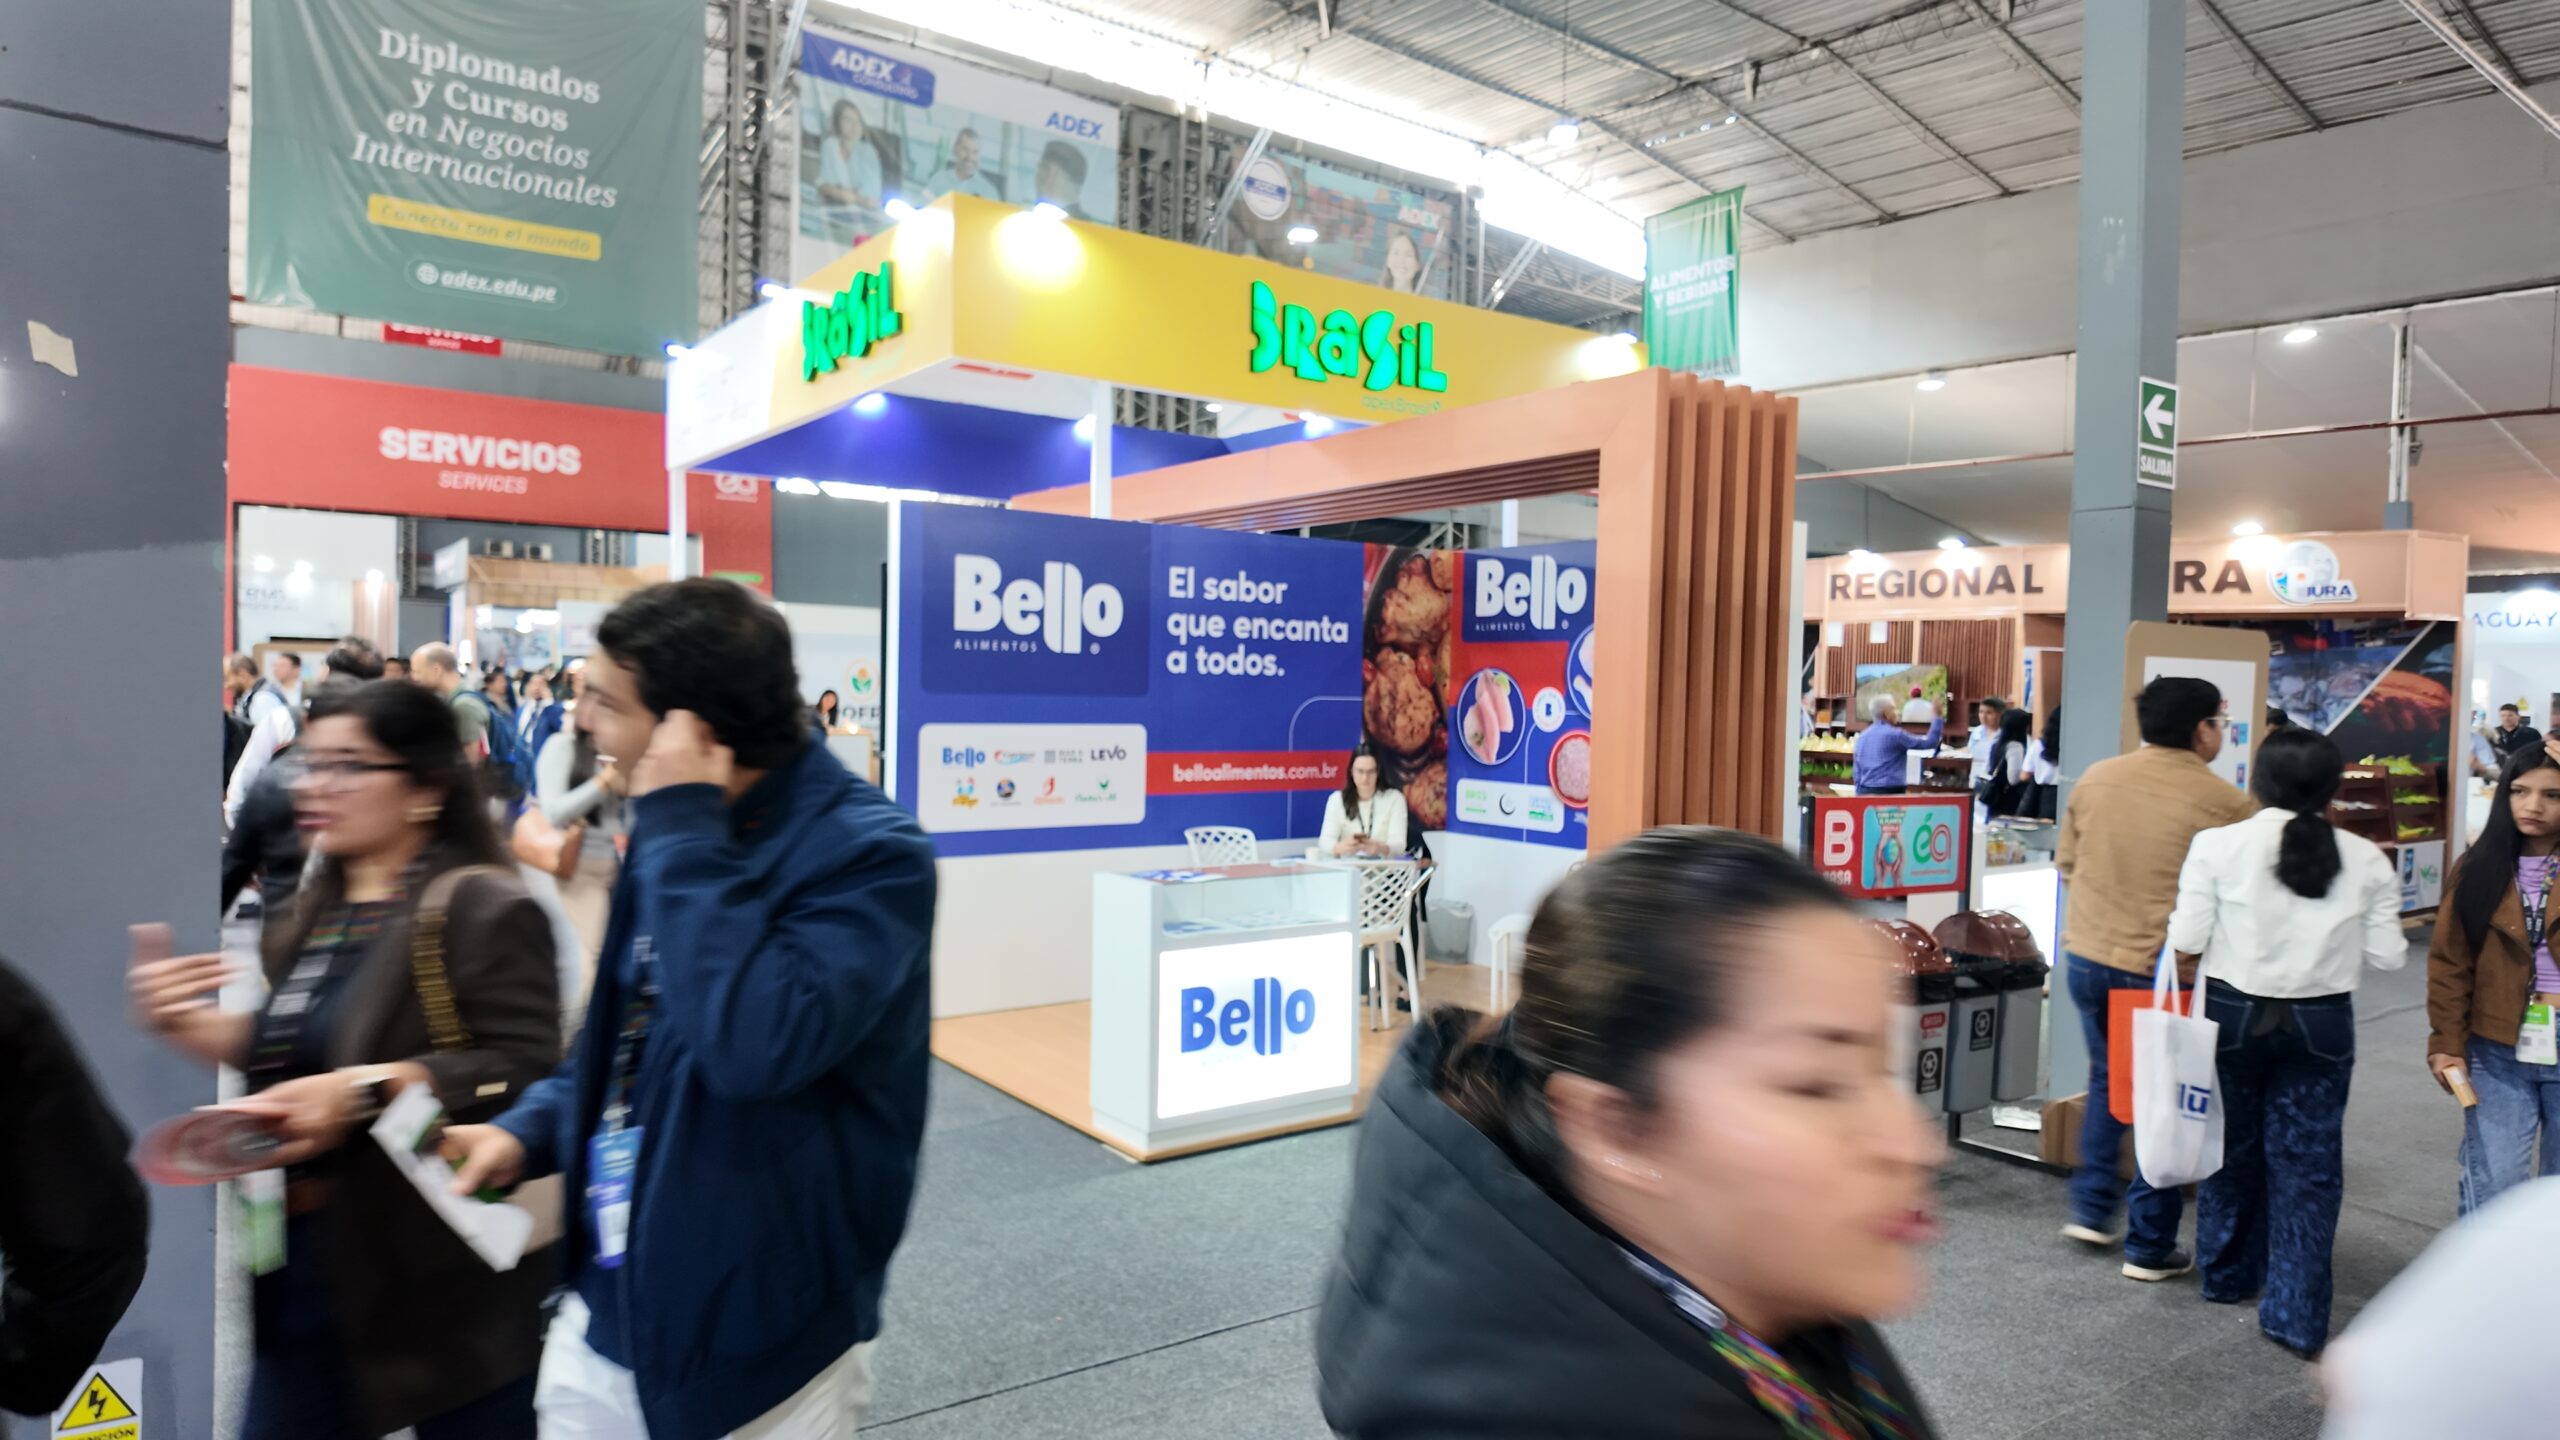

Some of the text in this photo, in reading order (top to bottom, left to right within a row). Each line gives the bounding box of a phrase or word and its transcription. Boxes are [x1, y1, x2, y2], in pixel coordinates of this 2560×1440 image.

[378, 28, 601, 104] Diplomados
[831, 48, 896, 82] ADEX
[411, 77, 568, 131] y Cursos
[386, 109, 591, 170] en Negocios
[1045, 112, 1104, 140] ADEX
[351, 132, 618, 208] Internacionales
[441, 270, 557, 303] adex.edu.pe
[1649, 255, 1735, 293] ALIMENTOS
[1666, 273, 1730, 307] BEBIDAS
[378, 426, 582, 476] SERVICIOS
[2140, 455, 2172, 477] SALIDA
[438, 470, 528, 495] SERVICES
[1168, 566, 1288, 604] El sabor
[1475, 554, 1588, 630] Bello
[1830, 564, 2045, 600] REGIONAL
[953, 553, 1124, 655] Bello
[1166, 610, 1349, 645] que encanta
[1474, 622, 1526, 632] ALIMENTOS
[953, 638, 1038, 653] ALIMENTOS
[1166, 645, 1286, 677] a todos.
[942, 747, 986, 768] Bello
[1090, 745, 1127, 761] LEVO
[1172, 761, 1339, 783] belloalimentos.com.br
[1181, 976, 1316, 1057] Bello
